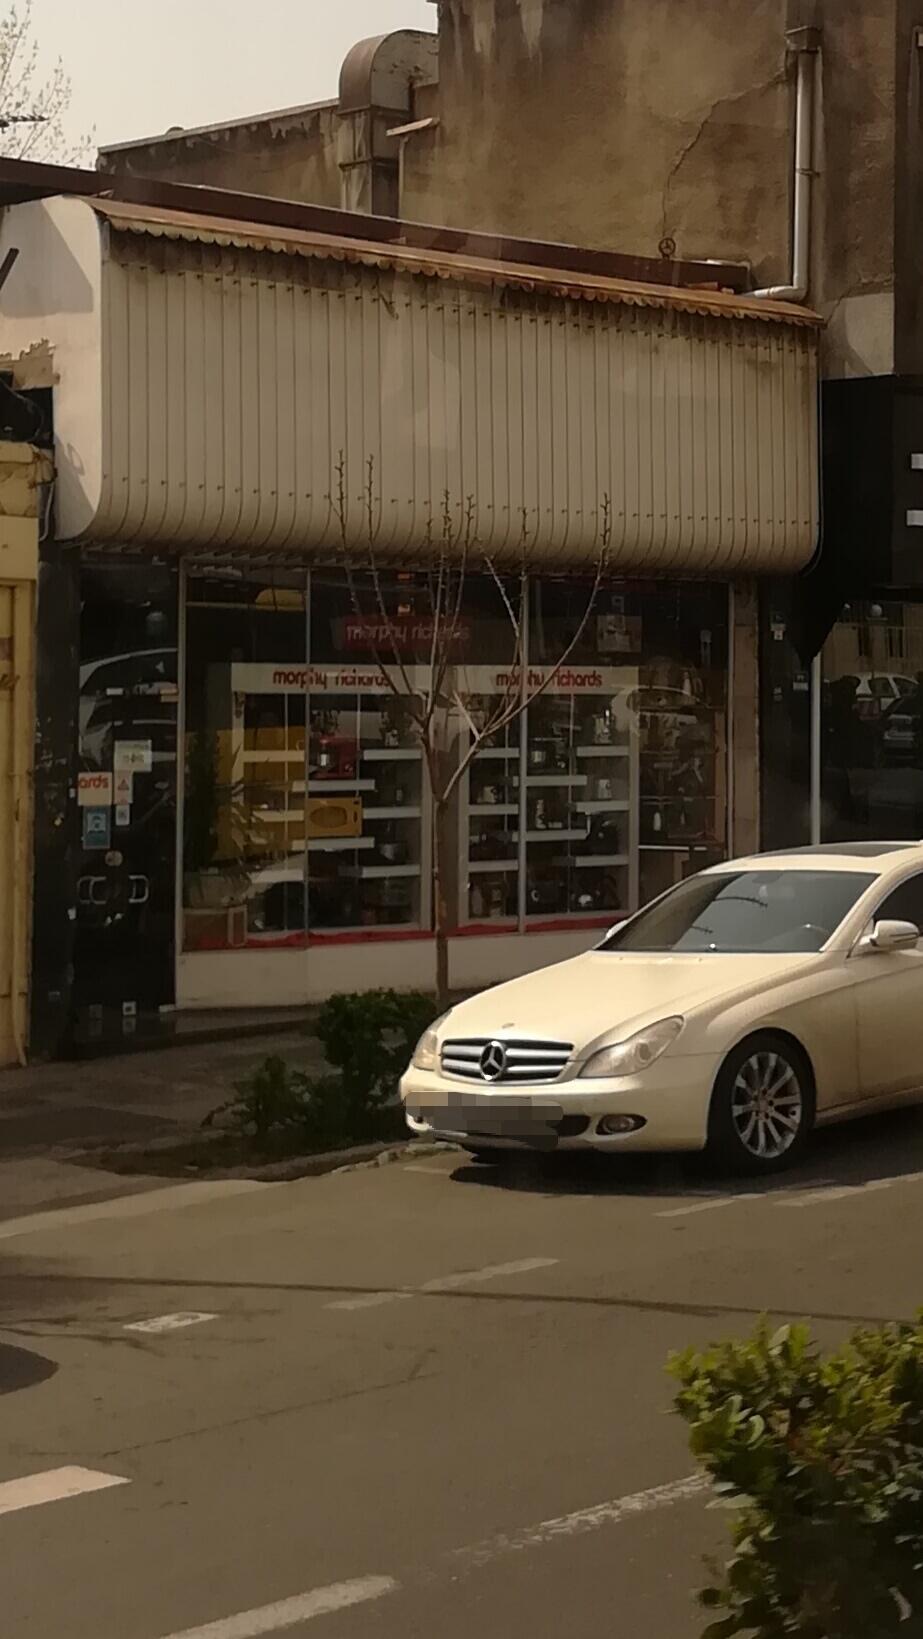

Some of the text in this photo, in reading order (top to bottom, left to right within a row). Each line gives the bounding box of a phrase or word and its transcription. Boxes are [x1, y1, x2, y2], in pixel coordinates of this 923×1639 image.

[411, 622, 470, 640] richds
[272, 667, 327, 689] morphy
[495, 669, 545, 687] morhy
